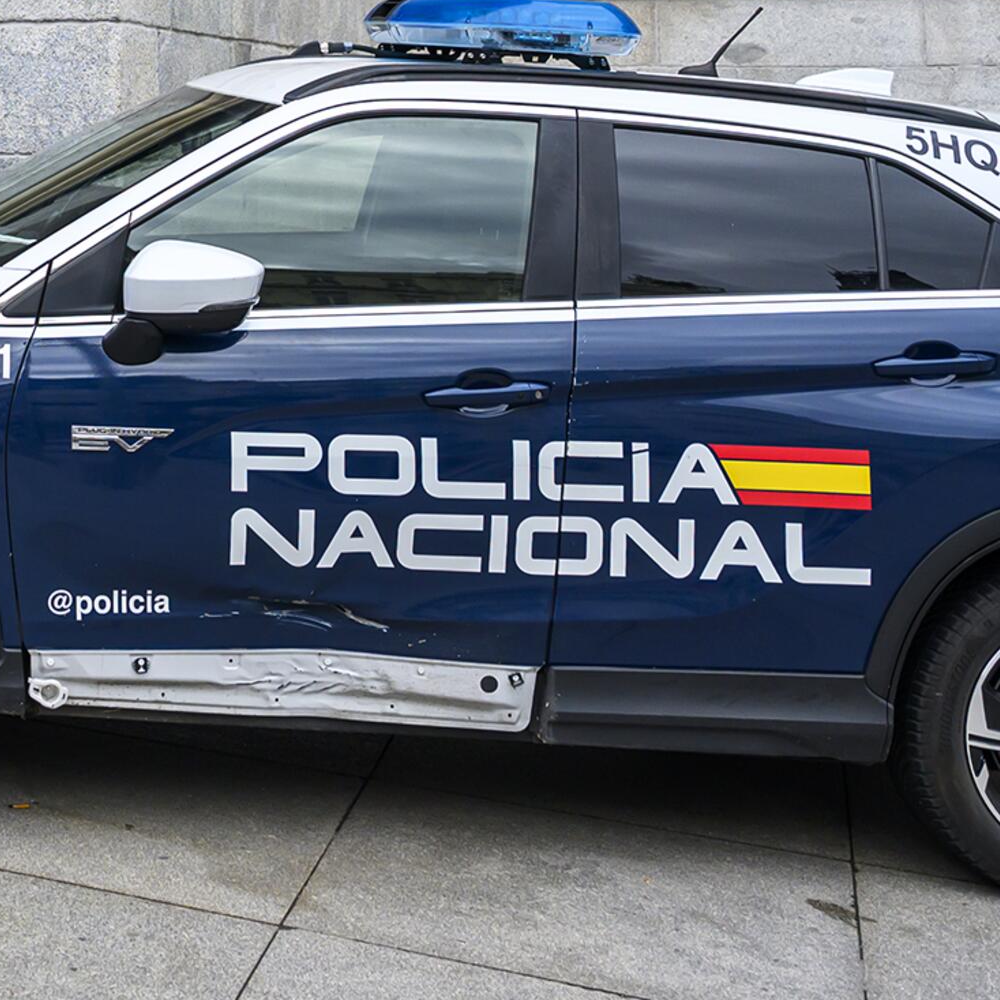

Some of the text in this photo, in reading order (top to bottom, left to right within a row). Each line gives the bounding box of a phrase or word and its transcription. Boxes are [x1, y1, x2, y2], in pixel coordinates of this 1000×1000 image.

[906, 125, 1000, 176] 5HQ
[229, 507, 872, 586] NACIONAL
[47, 589, 171, 622] @policia
